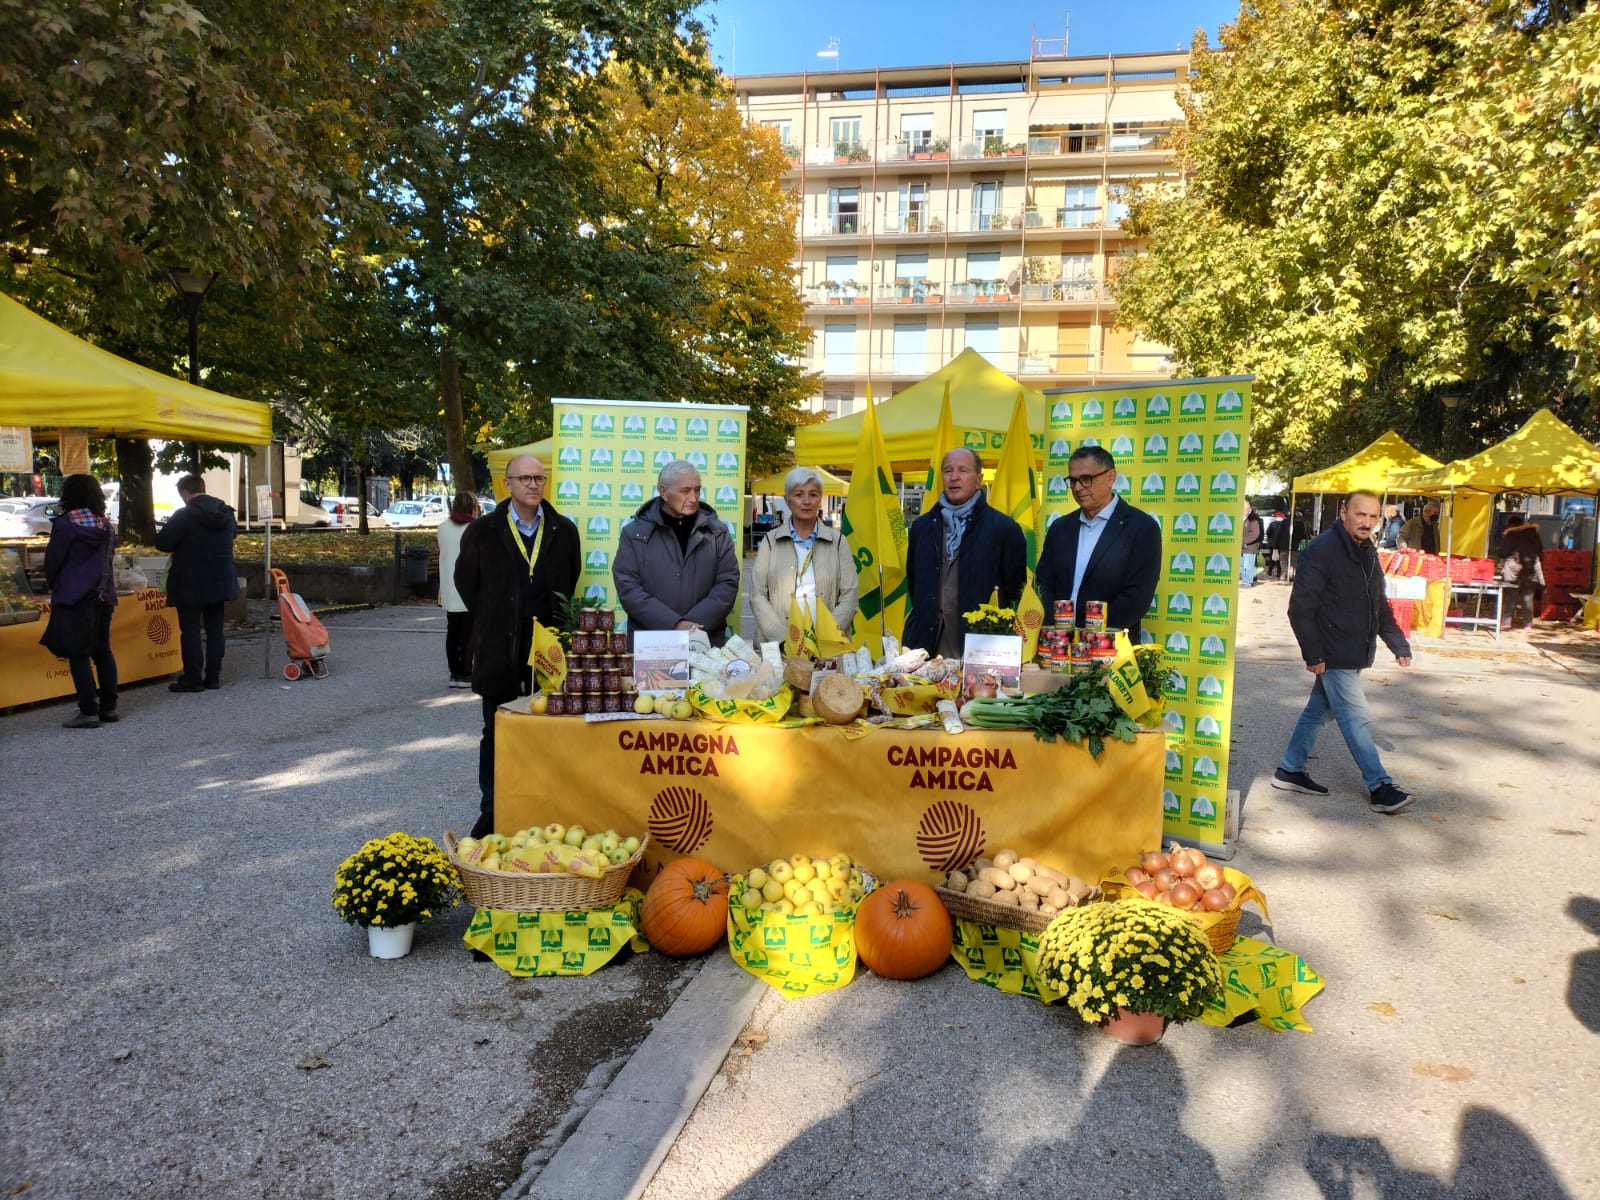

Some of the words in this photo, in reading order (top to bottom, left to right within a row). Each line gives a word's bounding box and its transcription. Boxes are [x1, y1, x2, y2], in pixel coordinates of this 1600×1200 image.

[618, 730, 740, 756] CAMPAGNA
[640, 755, 720, 776] AMICA
[887, 745, 1018, 770] CAMPAGNA
[909, 770, 994, 792] AMICA
